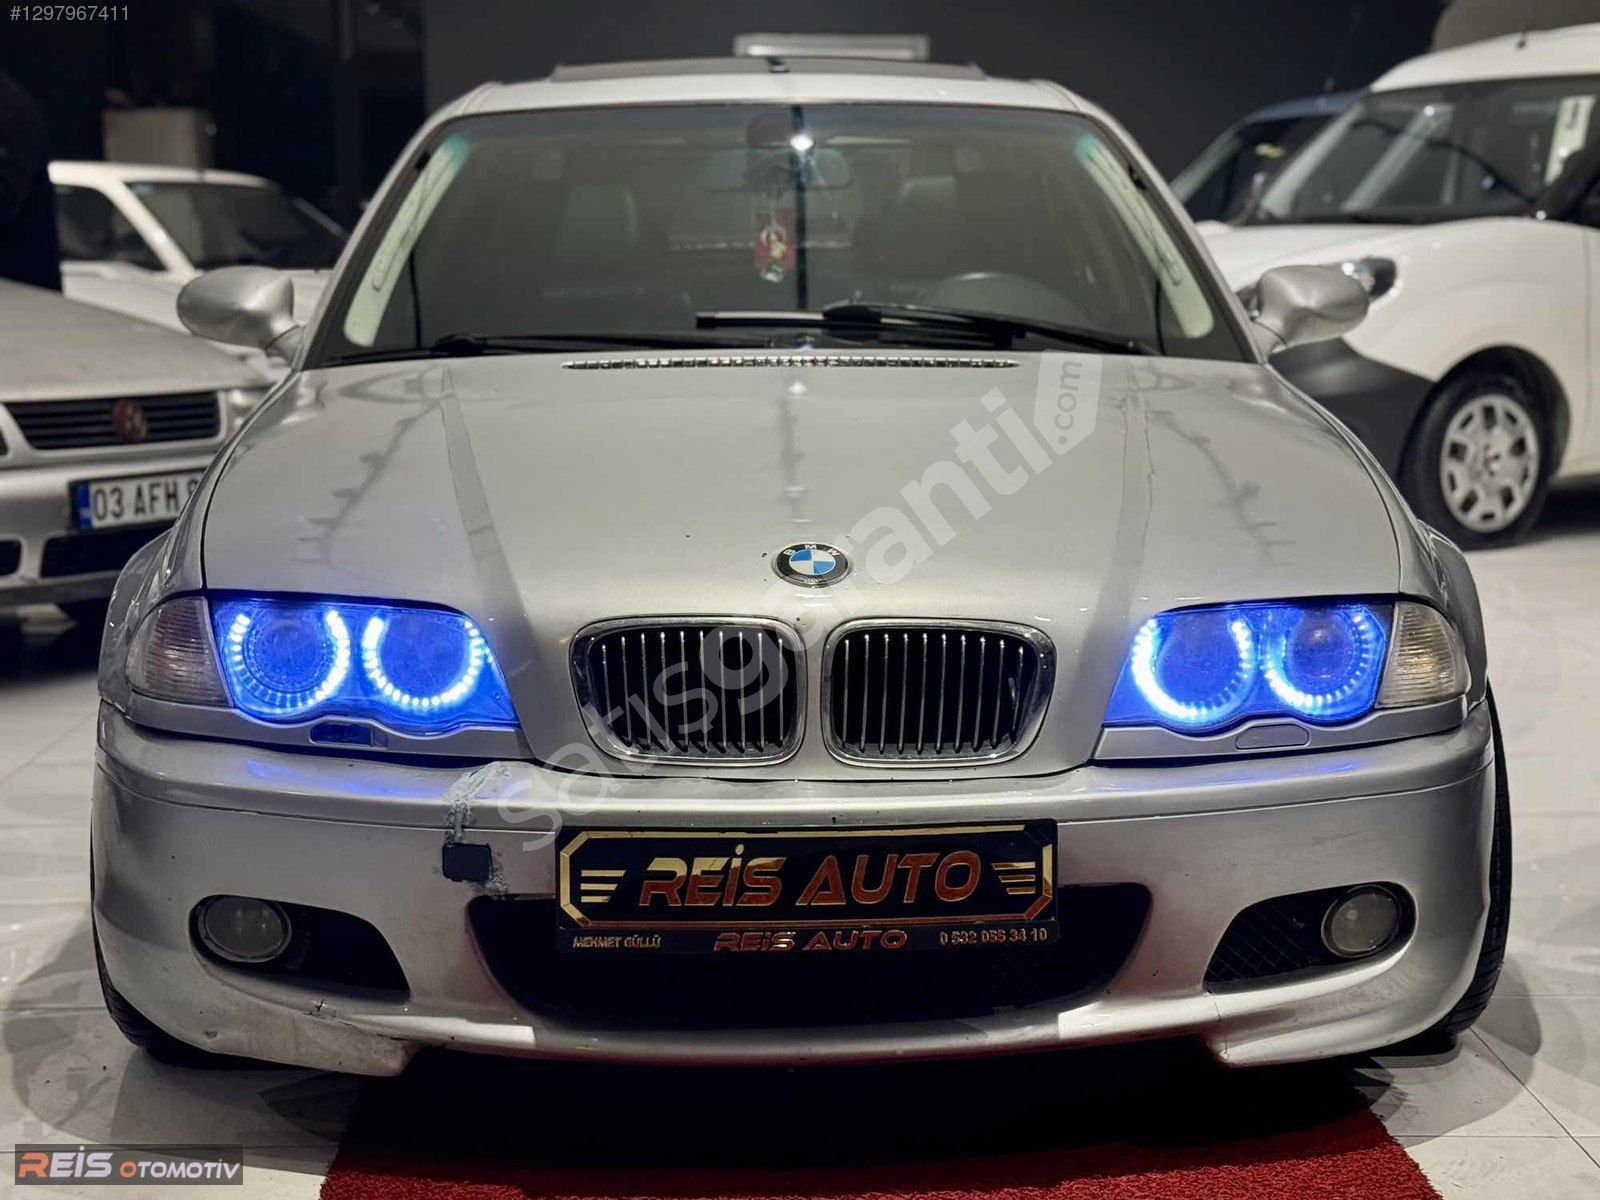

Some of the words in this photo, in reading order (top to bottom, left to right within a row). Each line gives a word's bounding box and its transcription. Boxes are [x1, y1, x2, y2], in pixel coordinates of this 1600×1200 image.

[93, 486, 125, 522] 03
[133, 480, 180, 517] AFH
[782, 543, 841, 557] BMW
[795, 849, 982, 906] AUTO
[572, 935, 622, 949] MEHMET
[624, 933, 662, 949] GÜLLÜ
[801, 929, 908, 951] AUTO
[938, 931, 949, 946] 0
[951, 929, 978, 945] 532
[1009, 928, 1027, 943] 34
[1030, 927, 1048, 942] 10
